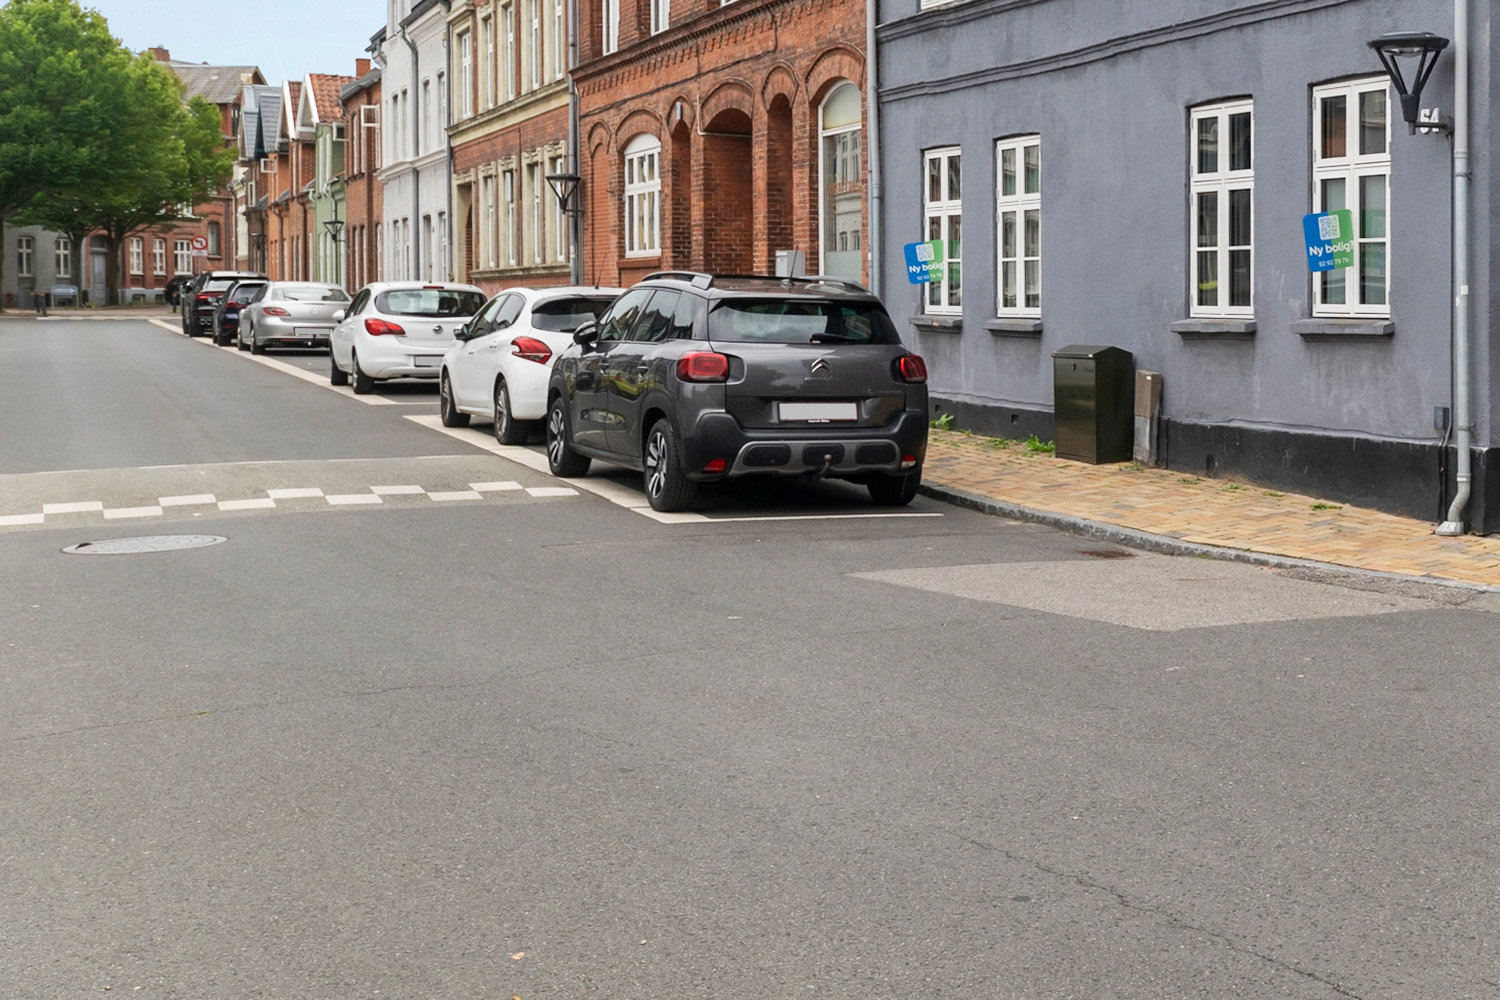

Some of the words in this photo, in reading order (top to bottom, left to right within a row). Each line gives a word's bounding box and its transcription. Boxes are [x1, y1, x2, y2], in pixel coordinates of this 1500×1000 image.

[1420, 108, 1439, 133] 54
[1309, 245, 1324, 257] Ny
[908, 265, 921, 274] Ny
